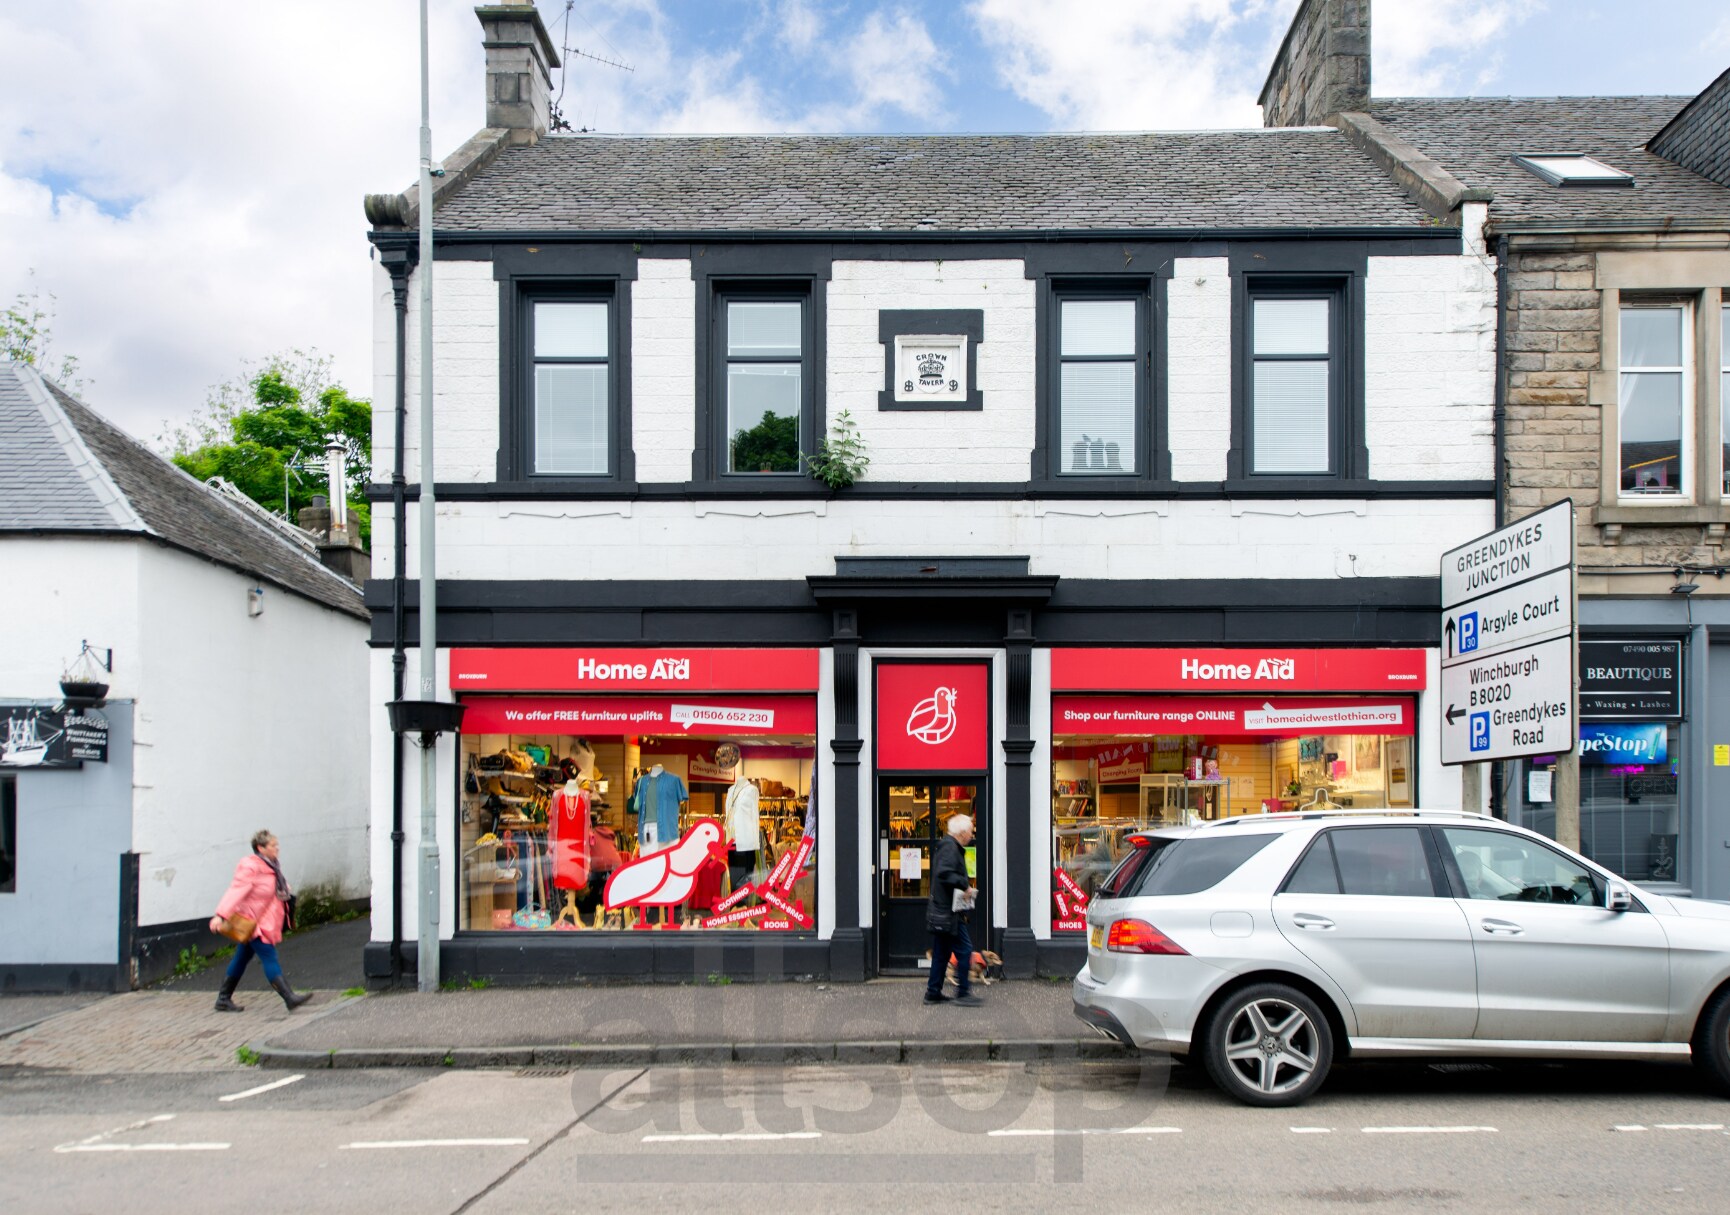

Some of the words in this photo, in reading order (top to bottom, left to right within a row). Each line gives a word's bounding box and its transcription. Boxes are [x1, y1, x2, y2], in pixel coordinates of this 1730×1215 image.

[916, 353, 947, 361] CROWN
[1457, 523, 1543, 573] GREENDYKES
[1466, 552, 1531, 592] JUNCTION
[1481, 609, 1518, 634] Argyle
[1522, 594, 1559, 621] Court
[1462, 617, 1474, 650] P
[578, 658, 647, 680] Home
[650, 657, 690, 680] Aid
[1181, 658, 1252, 680] Home
[1254, 657, 1295, 680] Aid
[1470, 654, 1539, 685] Winchburgh
[1586, 667, 1672, 681] BEAUTIQUE
[505, 710, 524, 720] We
[525, 710, 552, 720] offer
[553, 710, 580, 720] FREE
[581, 710, 628, 720] furniture
[630, 710, 663, 723] uplifts
[675, 711, 690, 719] CALL
[692, 710, 724, 720] 01506
[726, 711, 746, 721] 652
[748, 713, 768, 723] 230
[1064, 710, 1091, 722] Shop
[1093, 712, 1111, 720] our
[1113, 710, 1160, 720] furniture
[1162, 712, 1194, 723] range
[1196, 710, 1235, 721] ONLINE
[1493, 701, 1566, 726] Greendykes
[1595, 701, 1627, 709] Waxing
[1249, 717, 1264, 725] VISIT
[1266, 711, 1397, 724] homeaidwestlothian.org
[1472, 716, 1486, 749] P
[1512, 725, 1544, 746] Road
[1579, 734, 1648, 756] peStop
[1630, 779, 1675, 793] OPEN
[768, 852, 791, 886] JEWELLERY
[783, 843, 809, 891] KITCHENWARE
[1059, 872, 1074, 889] WALL
[1072, 887, 1085, 900] ART
[718, 887, 749, 911] CLOTHING
[765, 891, 804, 922] BRIC-A-BRAC
[1055, 893, 1069, 917] MUSIC
[1073, 904, 1087, 915] GLA
[706, 916, 727, 928] HOME
[728, 906, 767, 921] ESSENTIALS
[764, 921, 789, 929] BOOKS
[1059, 921, 1082, 929] SHOES
